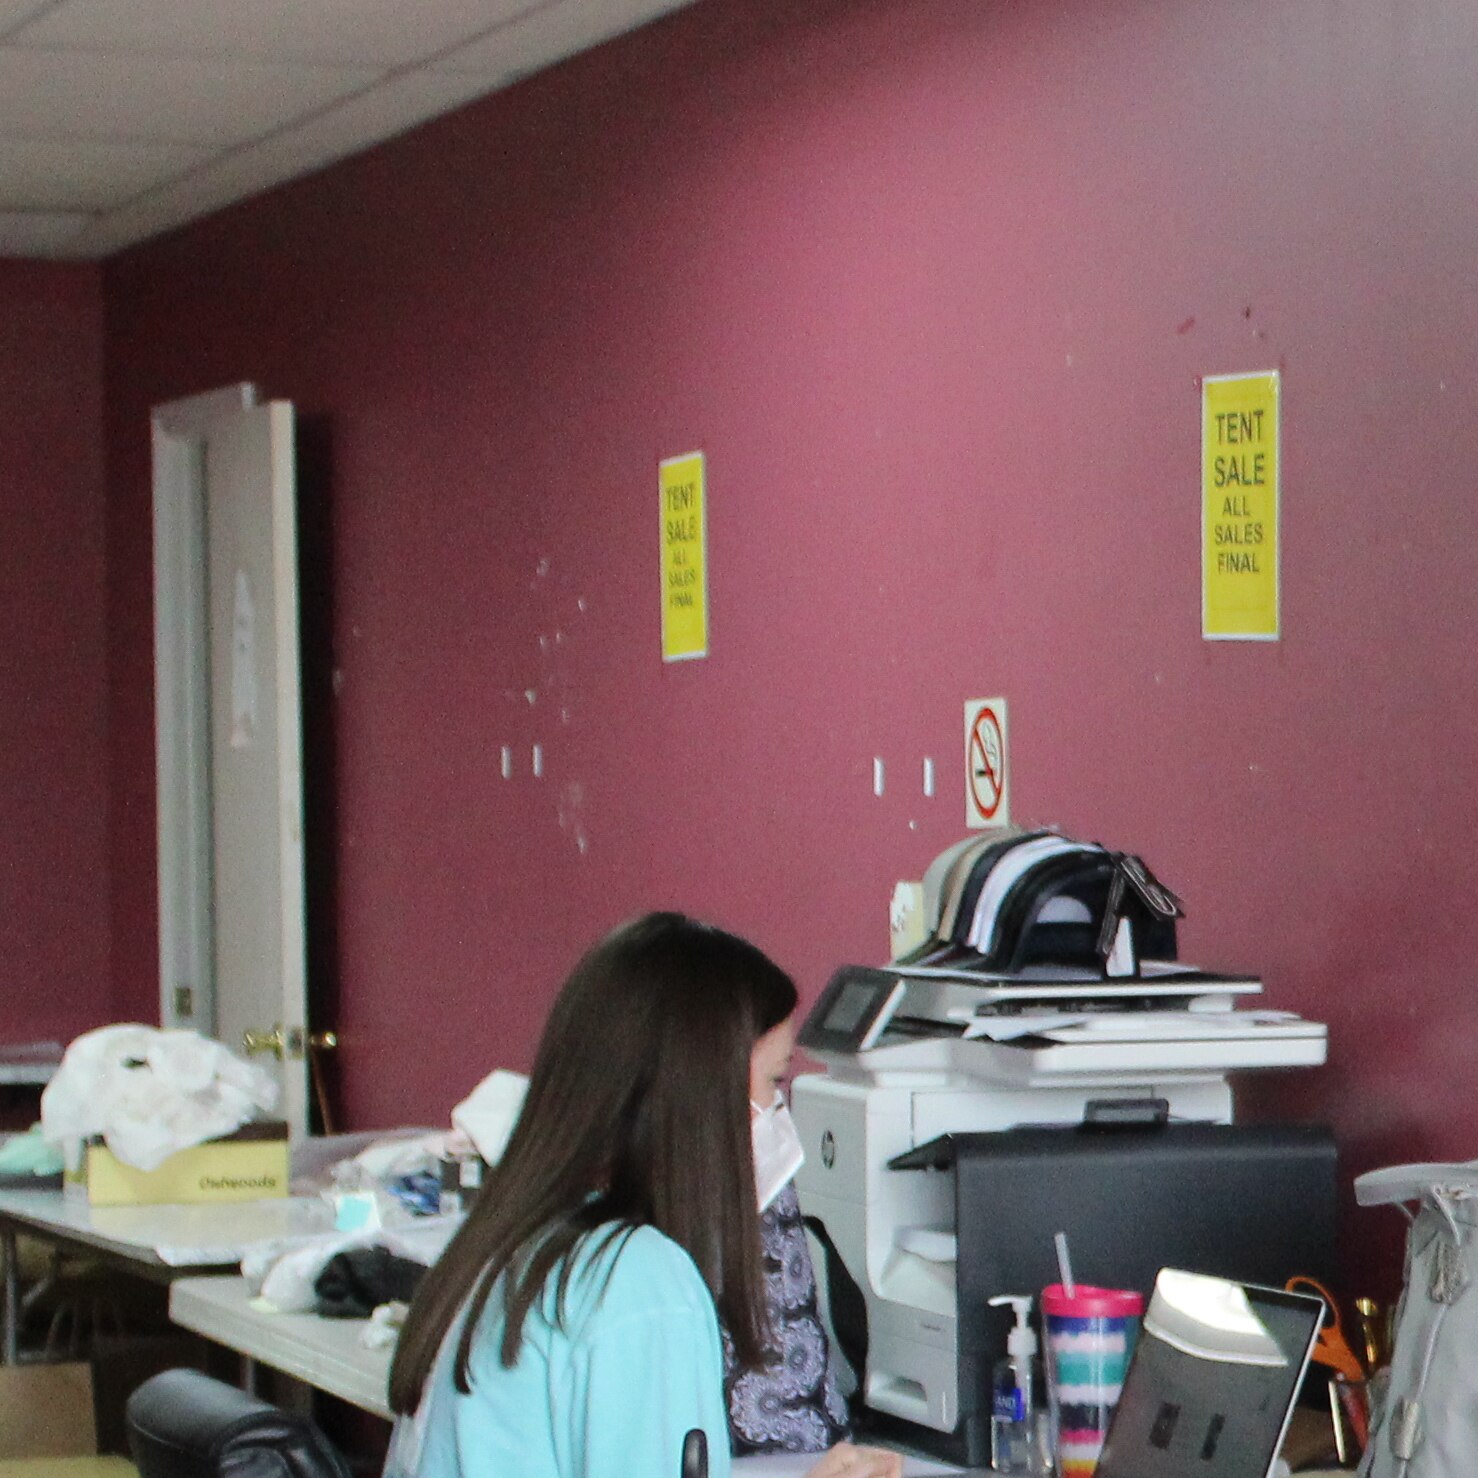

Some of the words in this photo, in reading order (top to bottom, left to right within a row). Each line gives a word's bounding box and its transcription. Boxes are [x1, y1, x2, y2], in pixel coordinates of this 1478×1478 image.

[1215, 409, 1264, 445] TENT
[1214, 453, 1265, 487] SALE
[665, 481, 695, 512] TENT
[1222, 496, 1251, 517] ALL
[666, 515, 696, 545] SALE
[1214, 523, 1263, 546] SALES
[1217, 552, 1260, 575] FINAL
